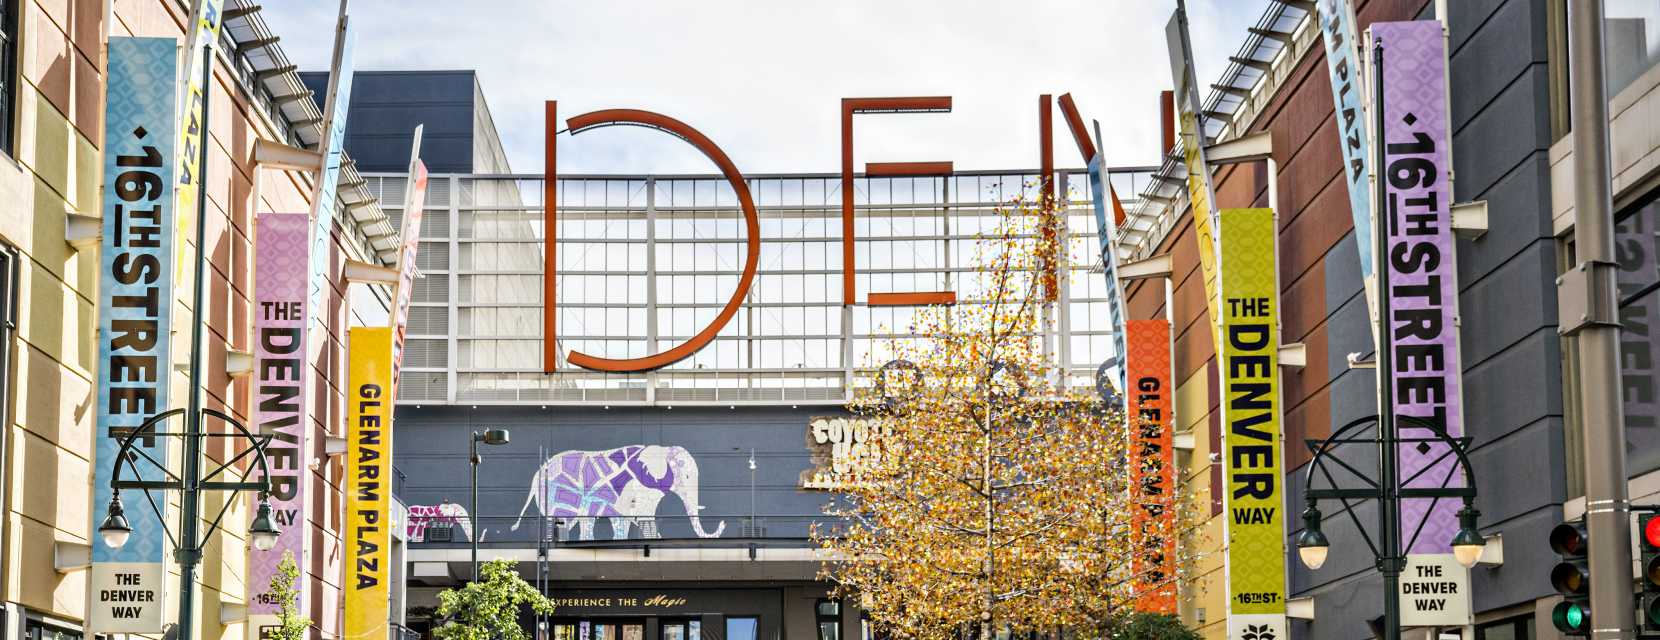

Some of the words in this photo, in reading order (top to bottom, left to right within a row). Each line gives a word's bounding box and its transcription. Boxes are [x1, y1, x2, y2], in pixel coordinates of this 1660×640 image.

[1335, 57, 1364, 184] PLAZA
[180, 88, 203, 186] LAZA
[260, 301, 302, 323] THE
[1227, 298, 1270, 318] THE
[259, 327, 301, 502] DENVER
[1229, 324, 1274, 501] DENVER
[358, 384, 381, 503] GLENARM
[1233, 507, 1275, 525] WAY
[356, 509, 379, 591] PLAZA
[114, 573, 141, 586] THE
[1415, 565, 1443, 578] THE
[100, 590, 154, 602] DENVER
[1402, 582, 1458, 595] DENVER
[550, 598, 611, 607] EXPERIENCE
[618, 598, 637, 607] THE
[644, 594, 687, 608] Magic
[1415, 599, 1446, 611] WAY
[111, 607, 143, 619] WAY
